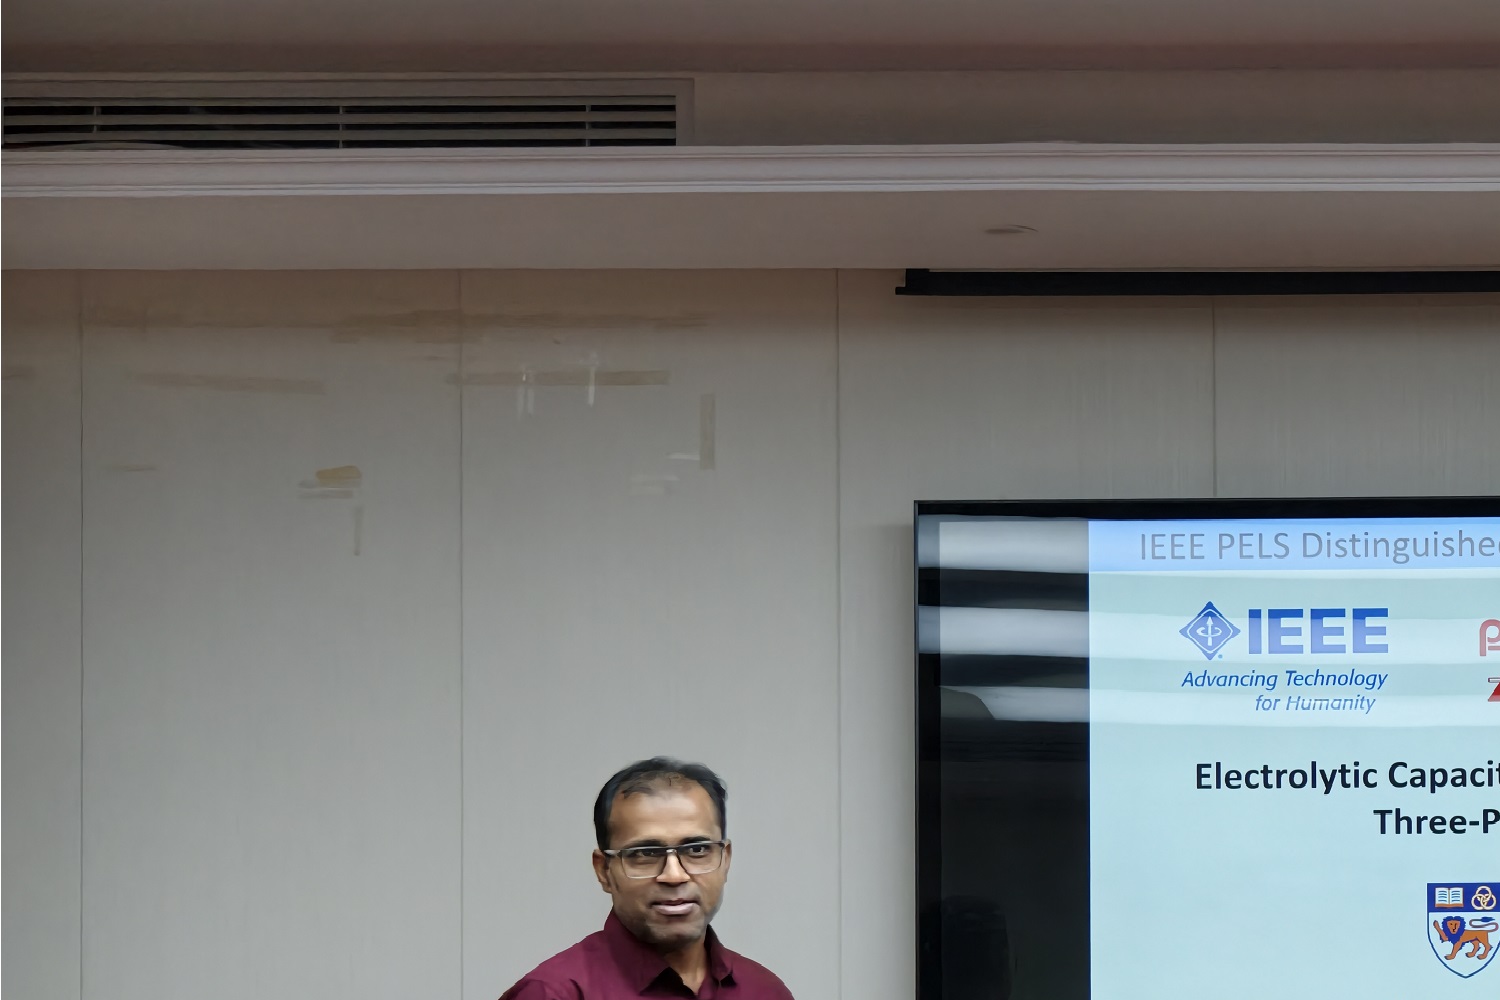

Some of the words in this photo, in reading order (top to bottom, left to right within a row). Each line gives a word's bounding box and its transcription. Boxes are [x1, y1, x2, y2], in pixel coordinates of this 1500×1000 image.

[1140, 533, 1205, 560] IEEE
[1217, 532, 1290, 560] PELS
[1247, 607, 1389, 655] IEEE
[1181, 669, 1277, 691] Advancing
[1285, 668, 1389, 691] Technology
[1255, 694, 1281, 712] for
[1285, 694, 1377, 715] Humanity
[1196, 760, 1378, 795] Electrolytic
